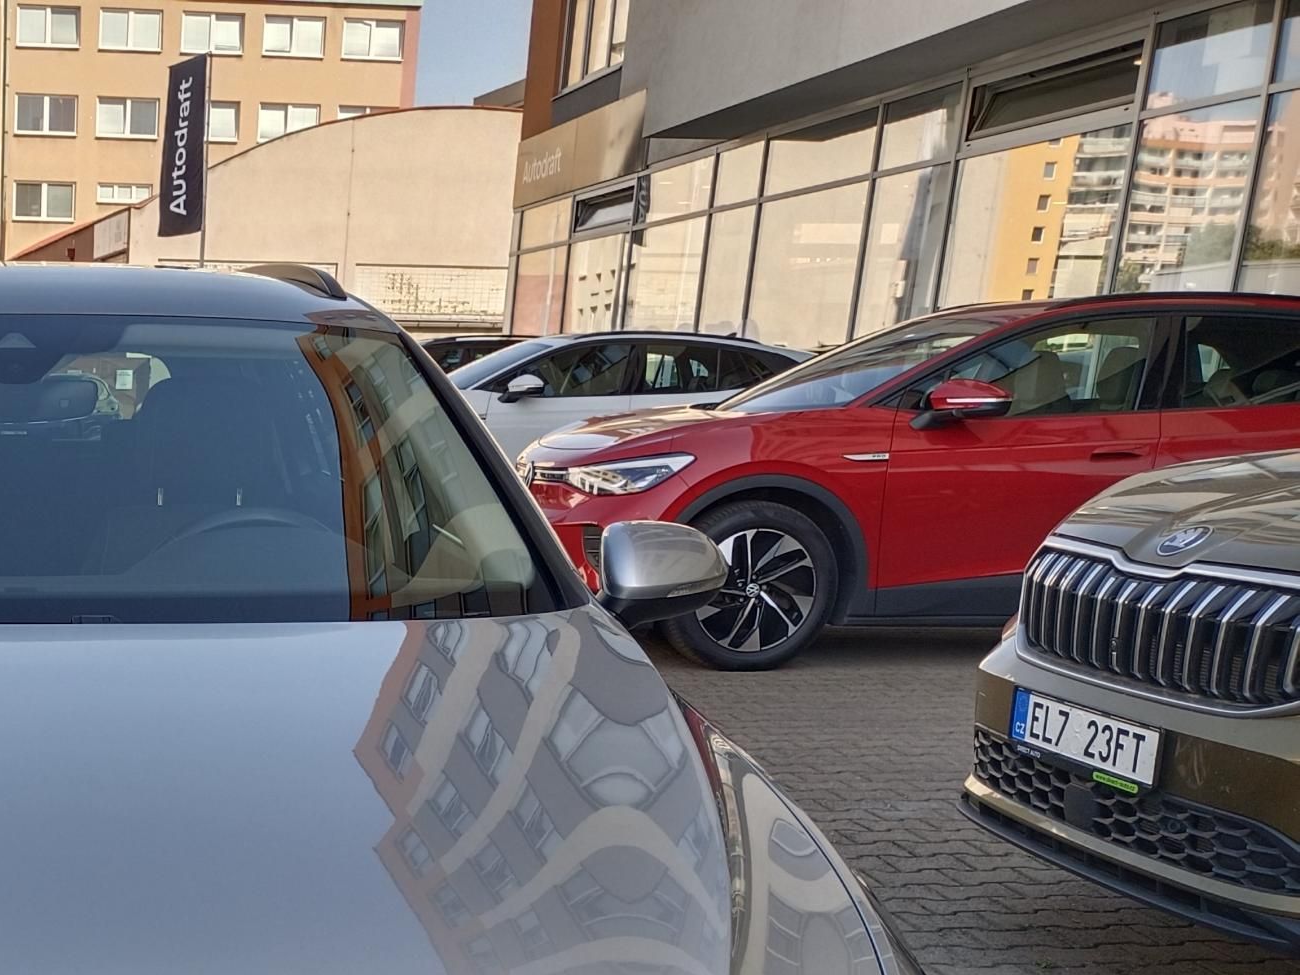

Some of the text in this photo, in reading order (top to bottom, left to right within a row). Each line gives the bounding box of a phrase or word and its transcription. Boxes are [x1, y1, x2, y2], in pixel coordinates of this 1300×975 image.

[170, 76, 193, 215] Autodraft
[522, 147, 562, 184] Autodraft
[1015, 722, 1025, 735] CZ
[1029, 701, 1146, 774] EL7 23FT
